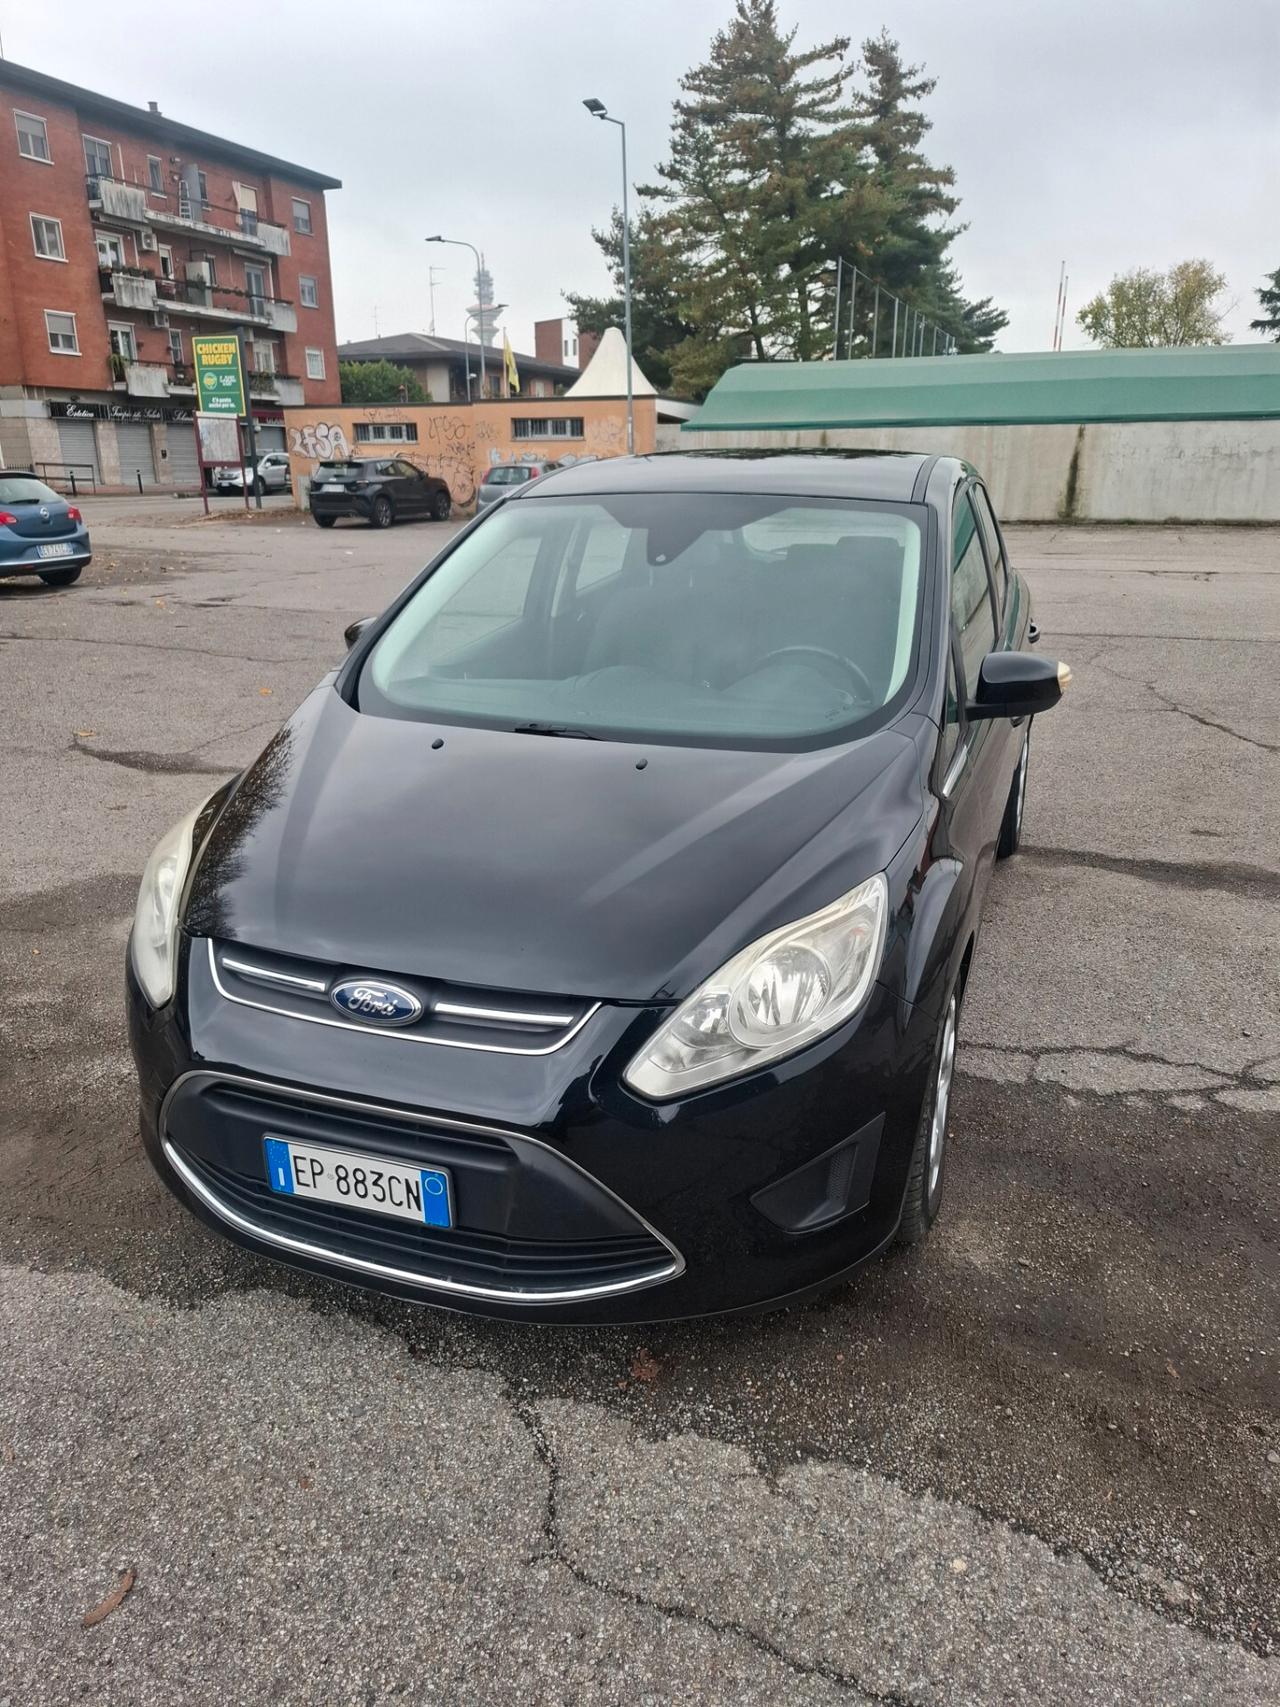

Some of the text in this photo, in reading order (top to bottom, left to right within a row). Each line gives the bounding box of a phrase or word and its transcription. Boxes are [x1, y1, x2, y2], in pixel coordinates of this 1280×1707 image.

[197, 343, 236, 354] CHICKEN
[202, 353, 233, 365] RUGBY
[348, 987, 399, 1016] Ford
[293, 1155, 324, 1188] EP
[335, 1164, 422, 1212] 883CN
